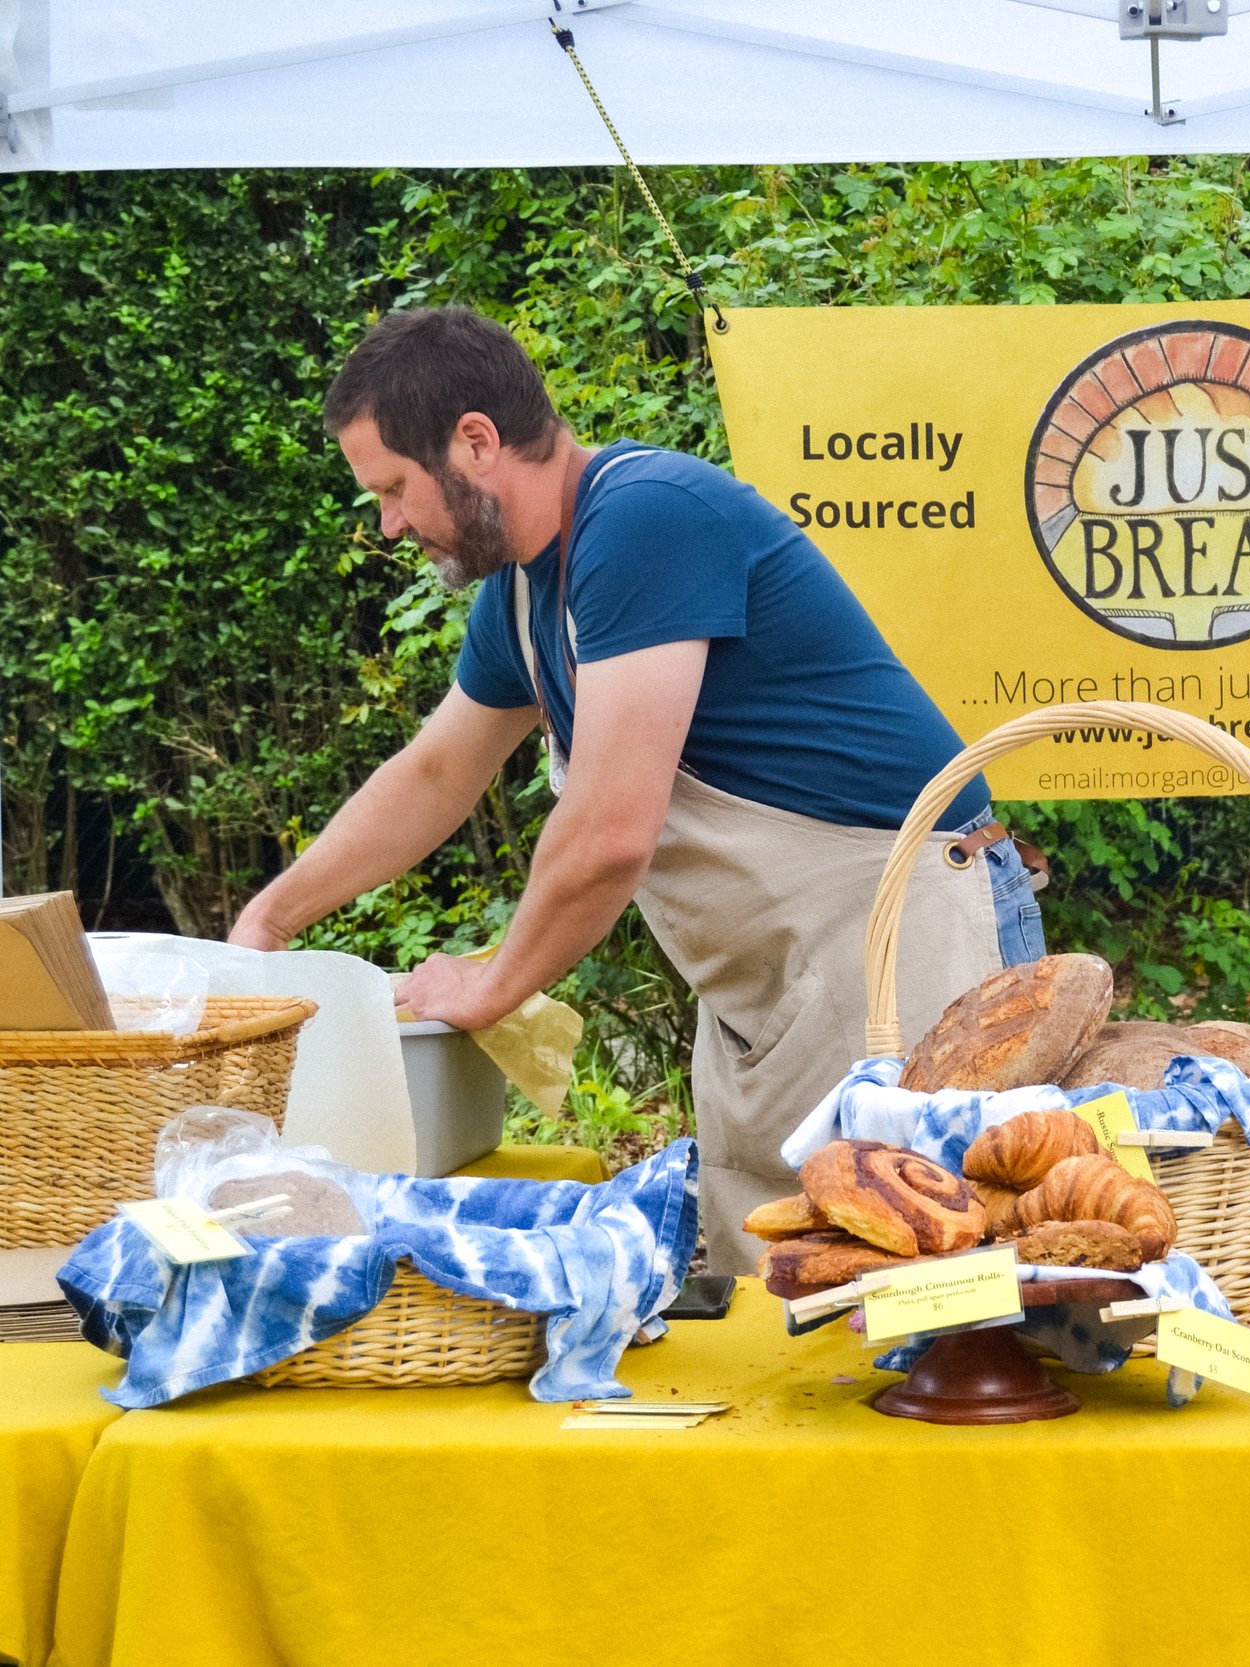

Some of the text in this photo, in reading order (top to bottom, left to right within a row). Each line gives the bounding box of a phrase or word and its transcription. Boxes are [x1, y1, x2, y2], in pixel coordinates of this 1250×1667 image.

[802, 422, 963, 472] Locally
[790, 491, 976, 529] Sourced
[1112, 667, 1202, 702] than
[868, 1272, 1005, 1301] -Sourdough Cinnamon Rolls-
[933, 1303, 943, 1311] $6
[1170, 1326, 1214, 1351] -Cranberry
[1215, 1343, 1230, 1356] Oat
[1209, 1364, 1218, 1374] $5
